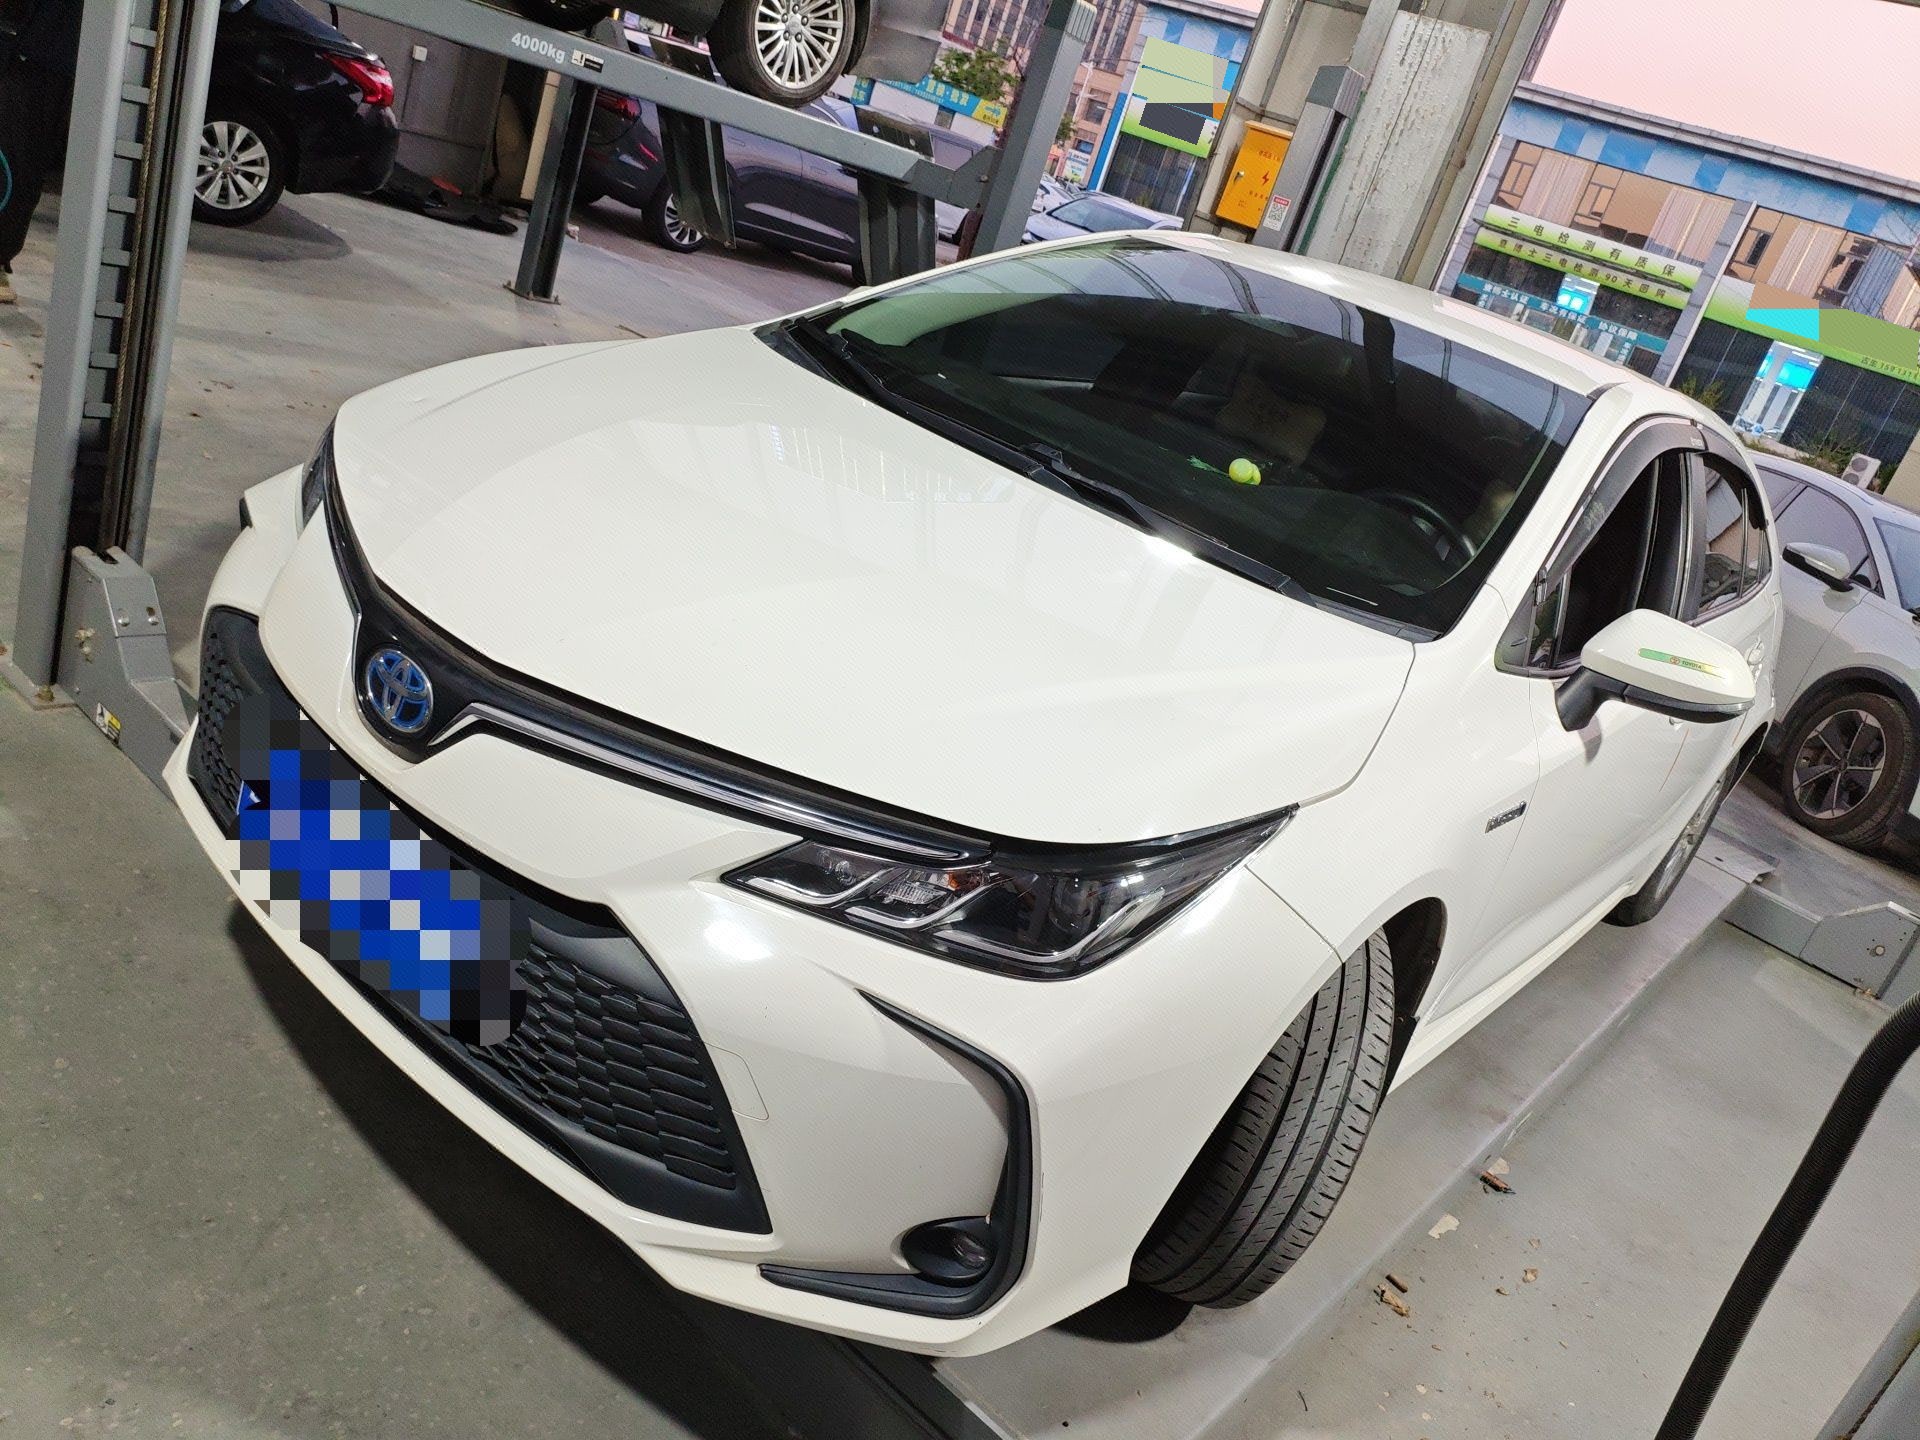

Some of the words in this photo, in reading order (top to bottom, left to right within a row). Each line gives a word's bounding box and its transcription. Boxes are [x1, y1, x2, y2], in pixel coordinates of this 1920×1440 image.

[511, 32, 566, 64] 4000kg
[1508, 217, 1676, 277] 三电检测有质保
